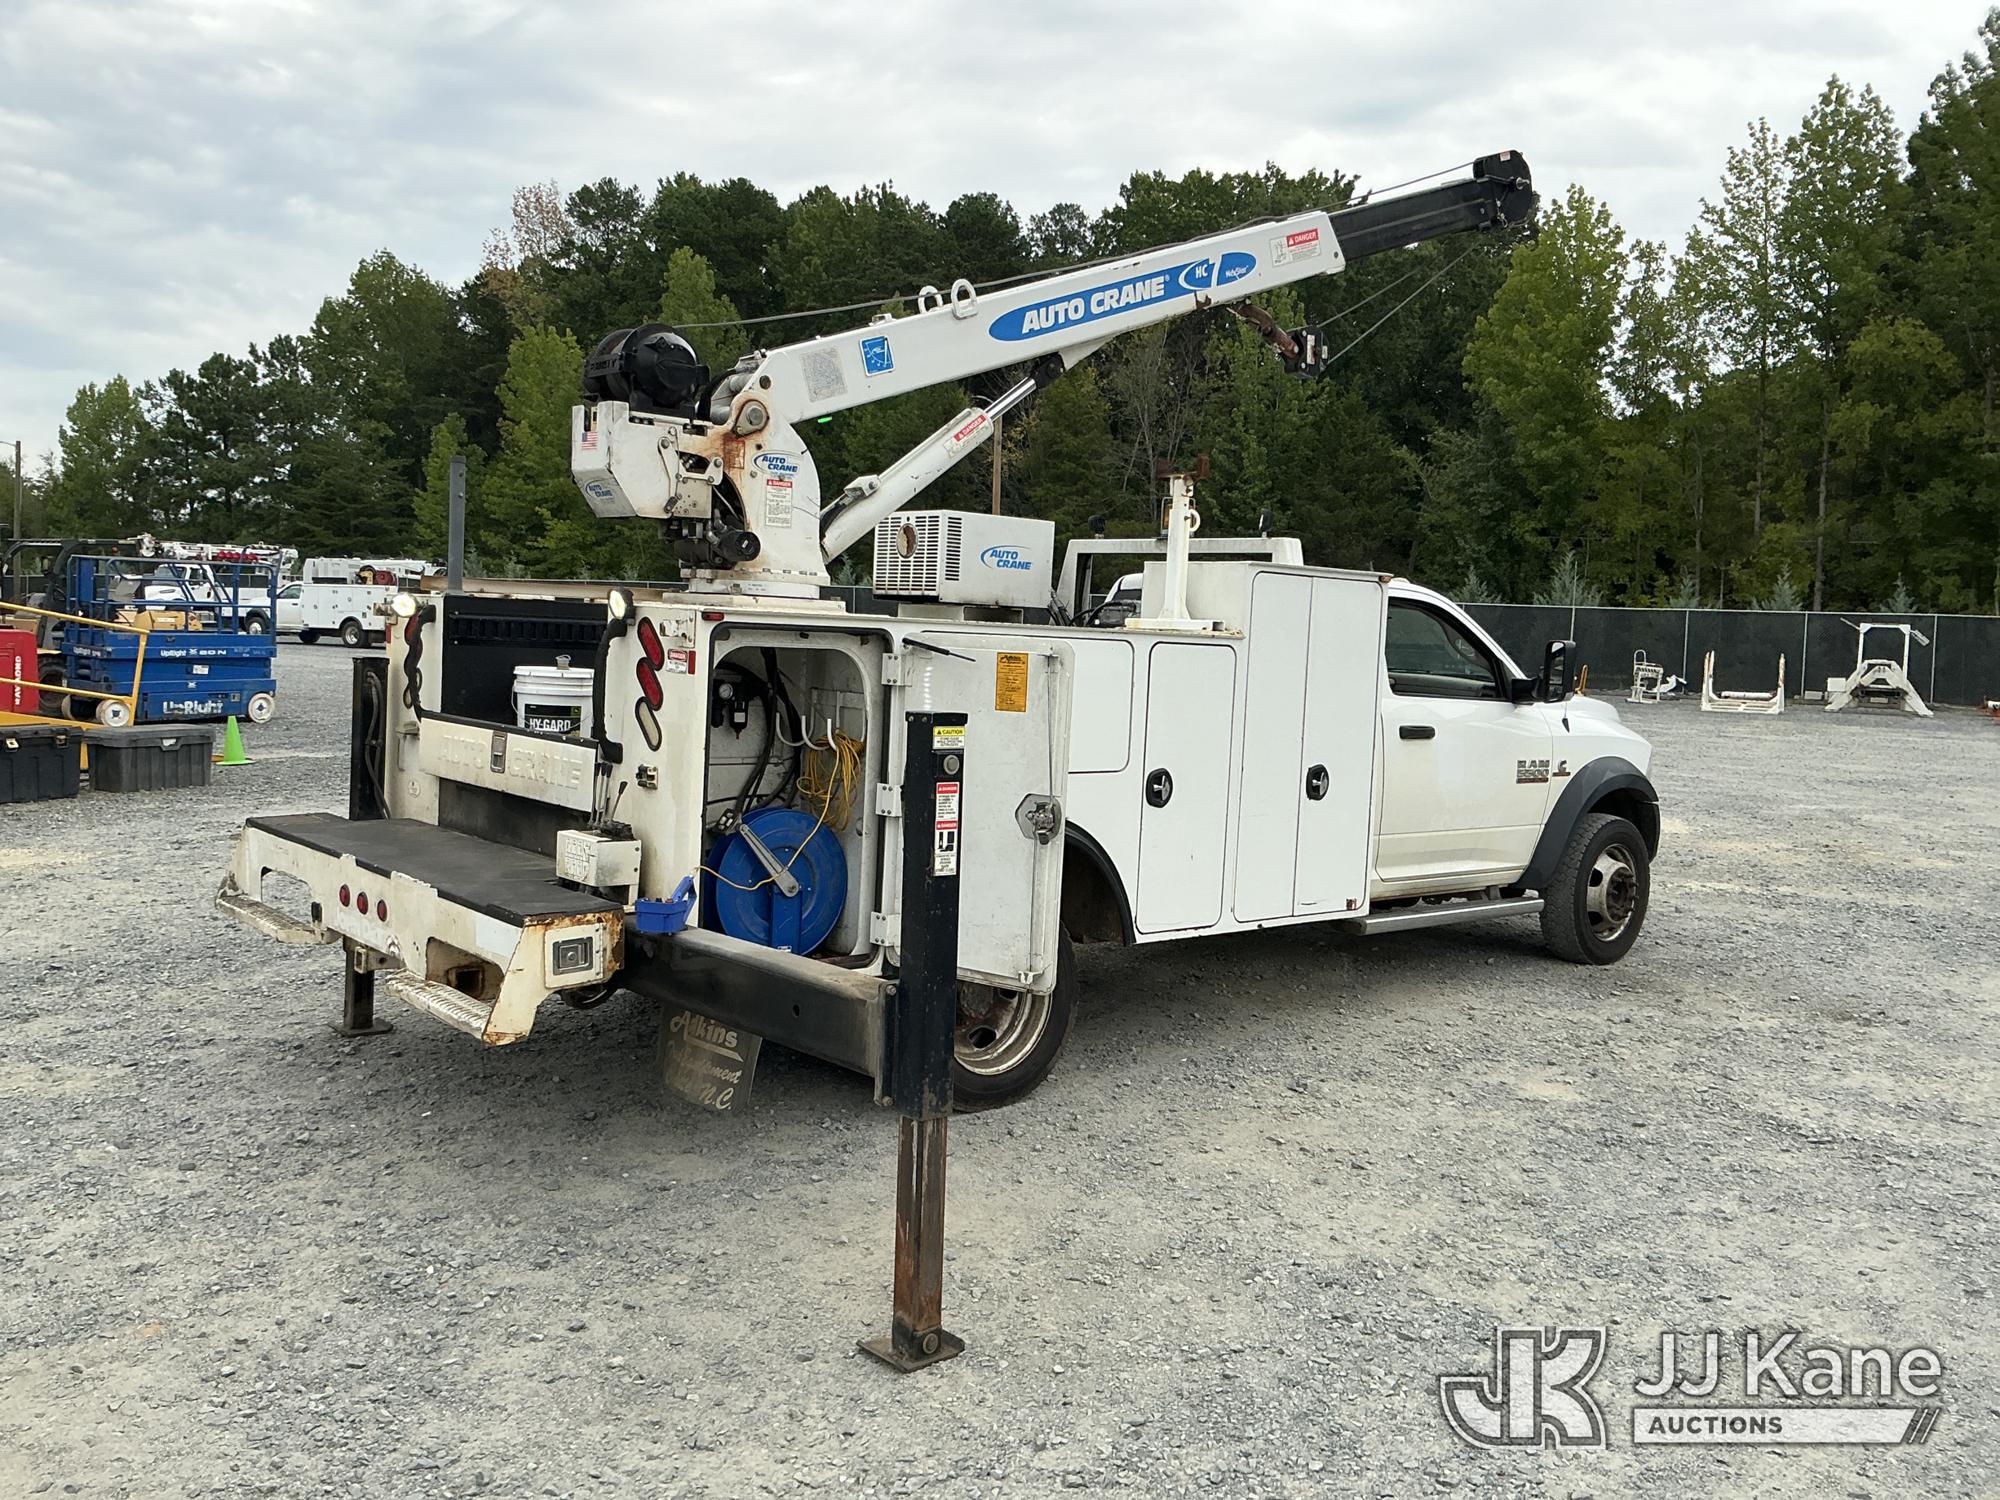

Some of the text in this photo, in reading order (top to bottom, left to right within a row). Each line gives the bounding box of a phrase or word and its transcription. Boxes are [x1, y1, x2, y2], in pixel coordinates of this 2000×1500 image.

[1294, 231, 1318, 243] DANGER
[1195, 264, 1208, 279] HC
[1021, 297, 1086, 335] AUTO
[762, 455, 786, 465] AUTO
[768, 463, 798, 473] CRANE
[990, 549, 1019, 560] AUTO
[996, 559, 1032, 570] CRANE
[529, 718, 571, 732] HY-GARD
[1517, 760, 1550, 769] RAM
